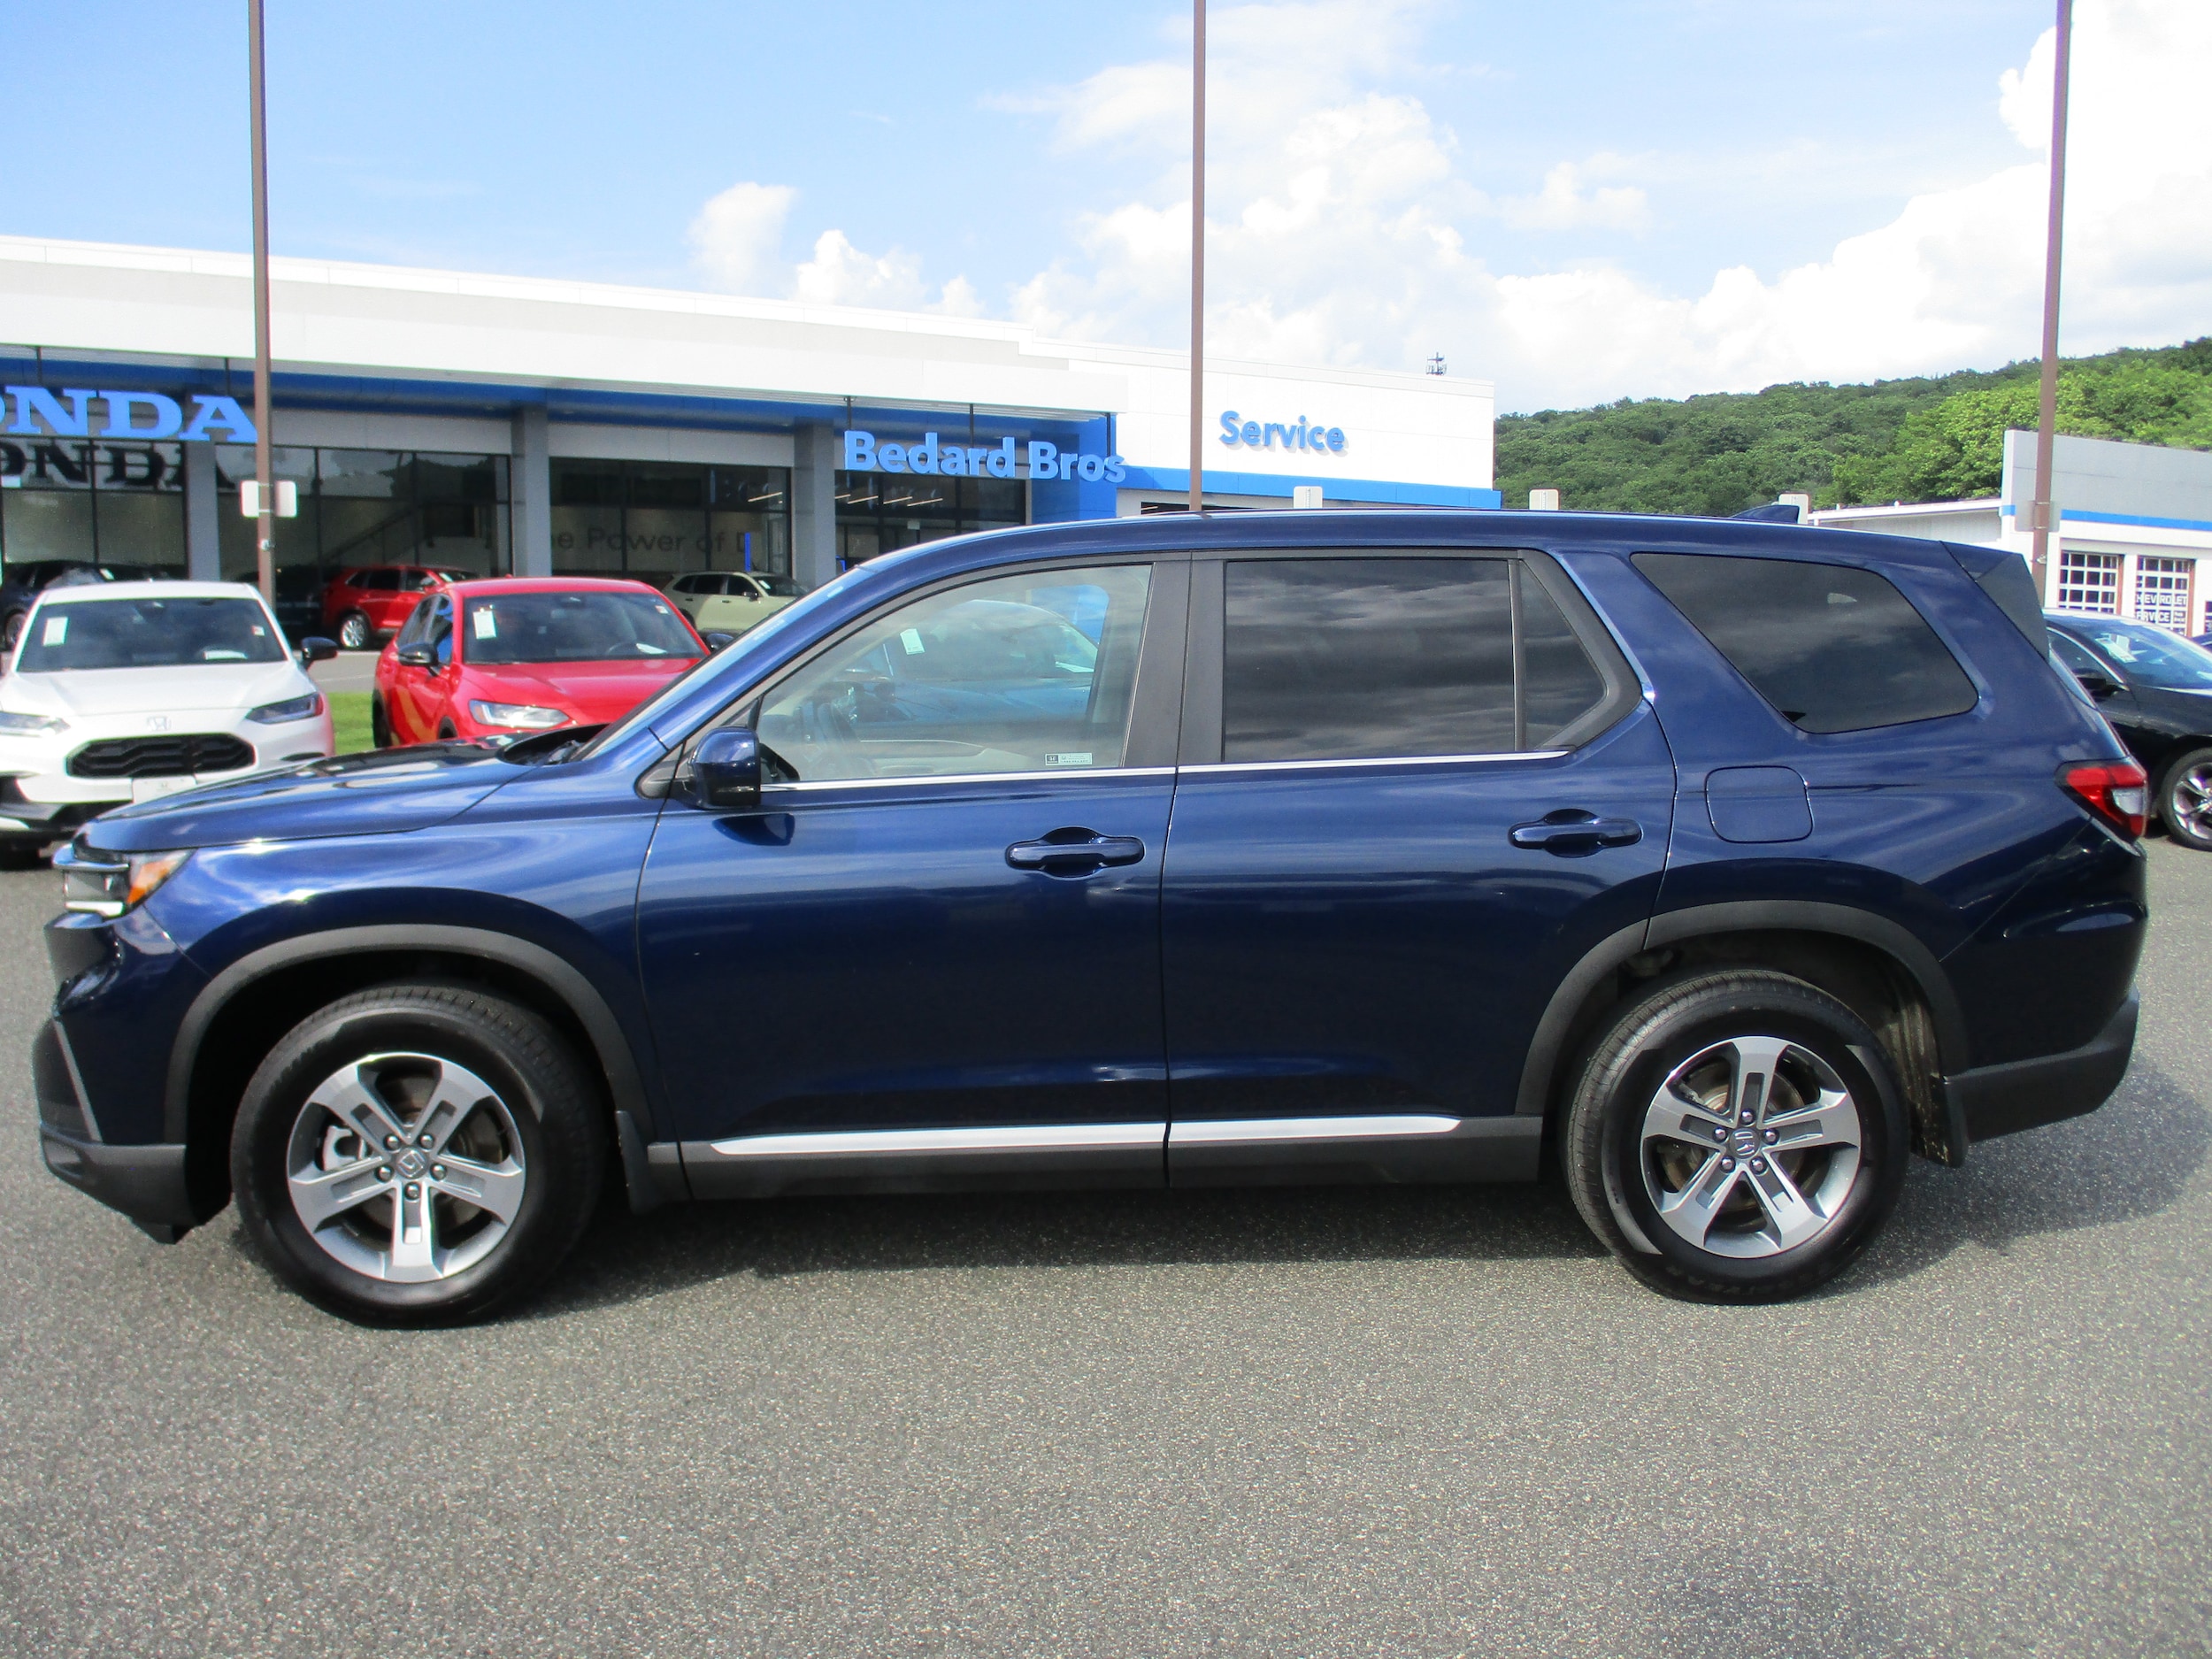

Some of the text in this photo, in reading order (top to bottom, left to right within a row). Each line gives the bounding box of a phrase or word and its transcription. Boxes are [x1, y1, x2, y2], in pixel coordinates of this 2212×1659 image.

[0, 385, 257, 443] NDA
[1219, 411, 1345, 452] Service
[844, 430, 1126, 483] Bedard Bros
[2135, 611, 2170, 623] ERVICE
[2136, 594, 2186, 606] HEVROLET
